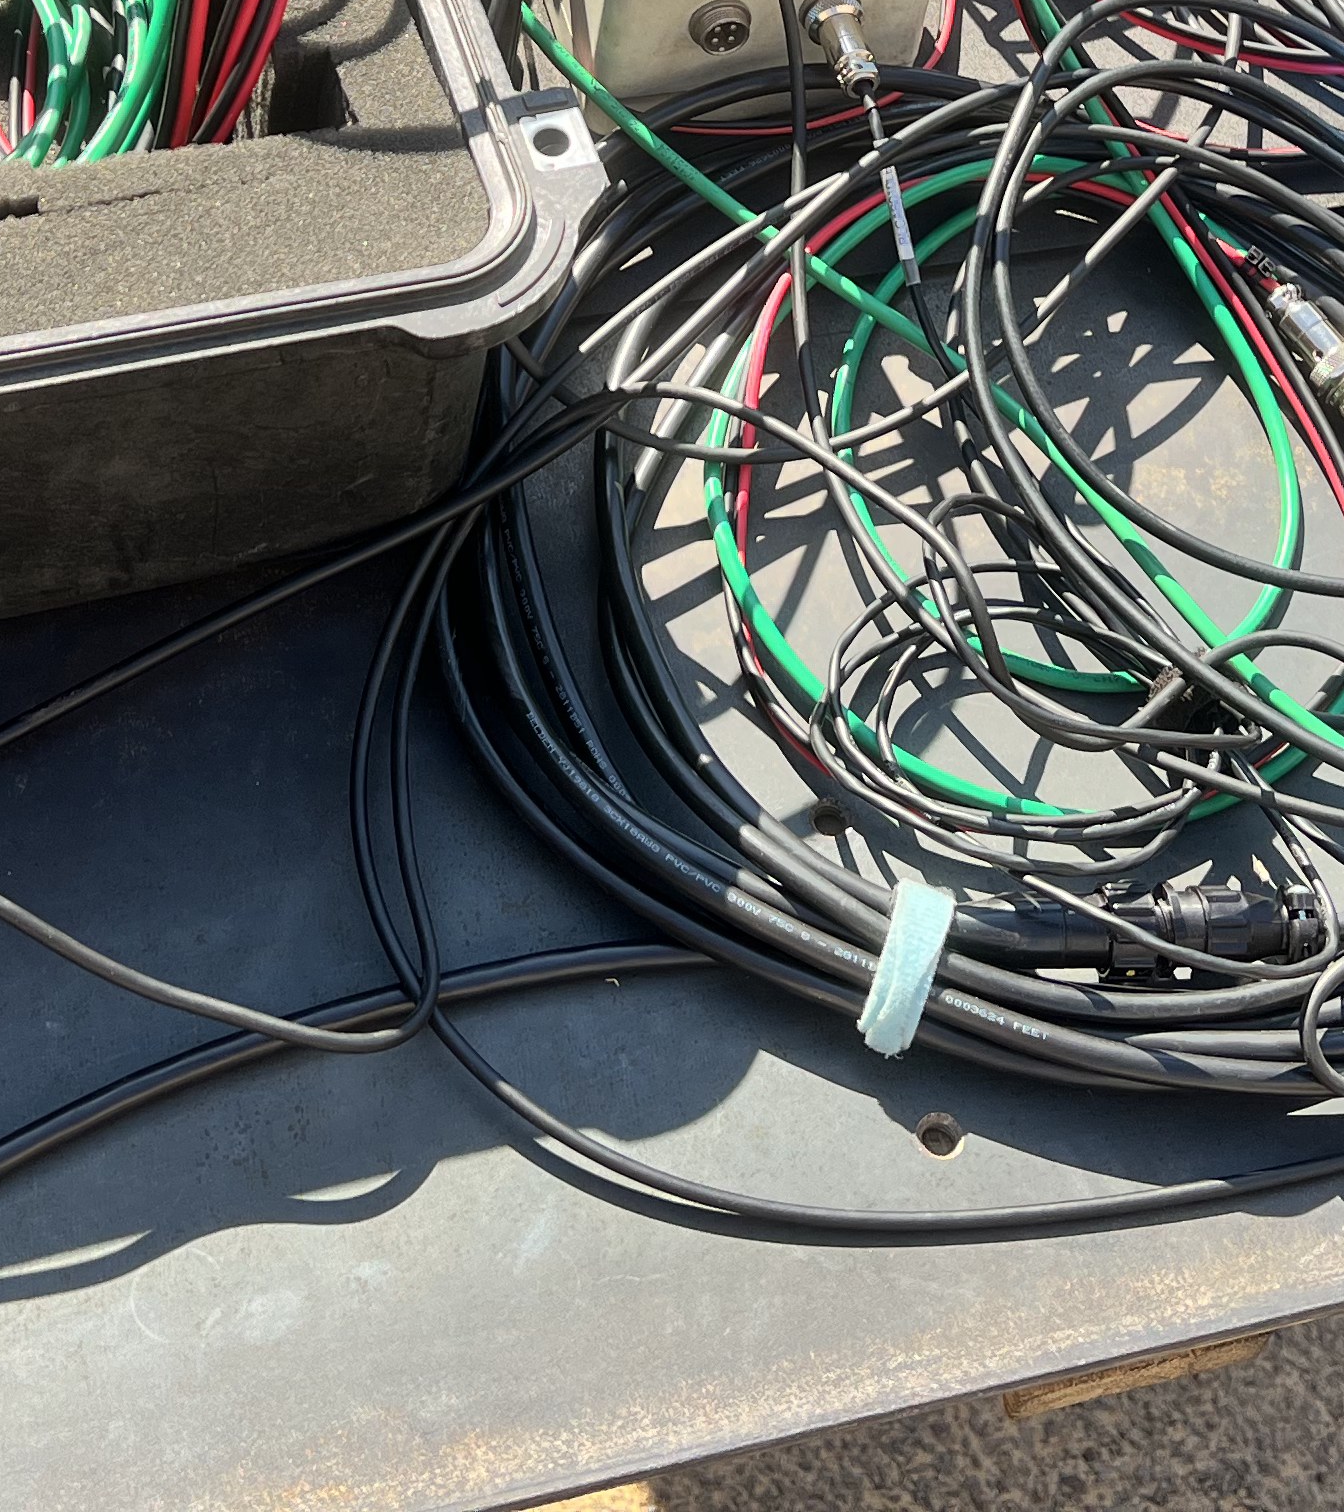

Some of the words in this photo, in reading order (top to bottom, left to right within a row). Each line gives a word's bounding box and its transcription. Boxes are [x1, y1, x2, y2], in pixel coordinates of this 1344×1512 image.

[524, 710, 557, 755] BELDEN
[663, 851, 723, 895] PVC/PVC
[765, 912, 797, 935] 75C
[1010, 1019, 1050, 1043] FEET
